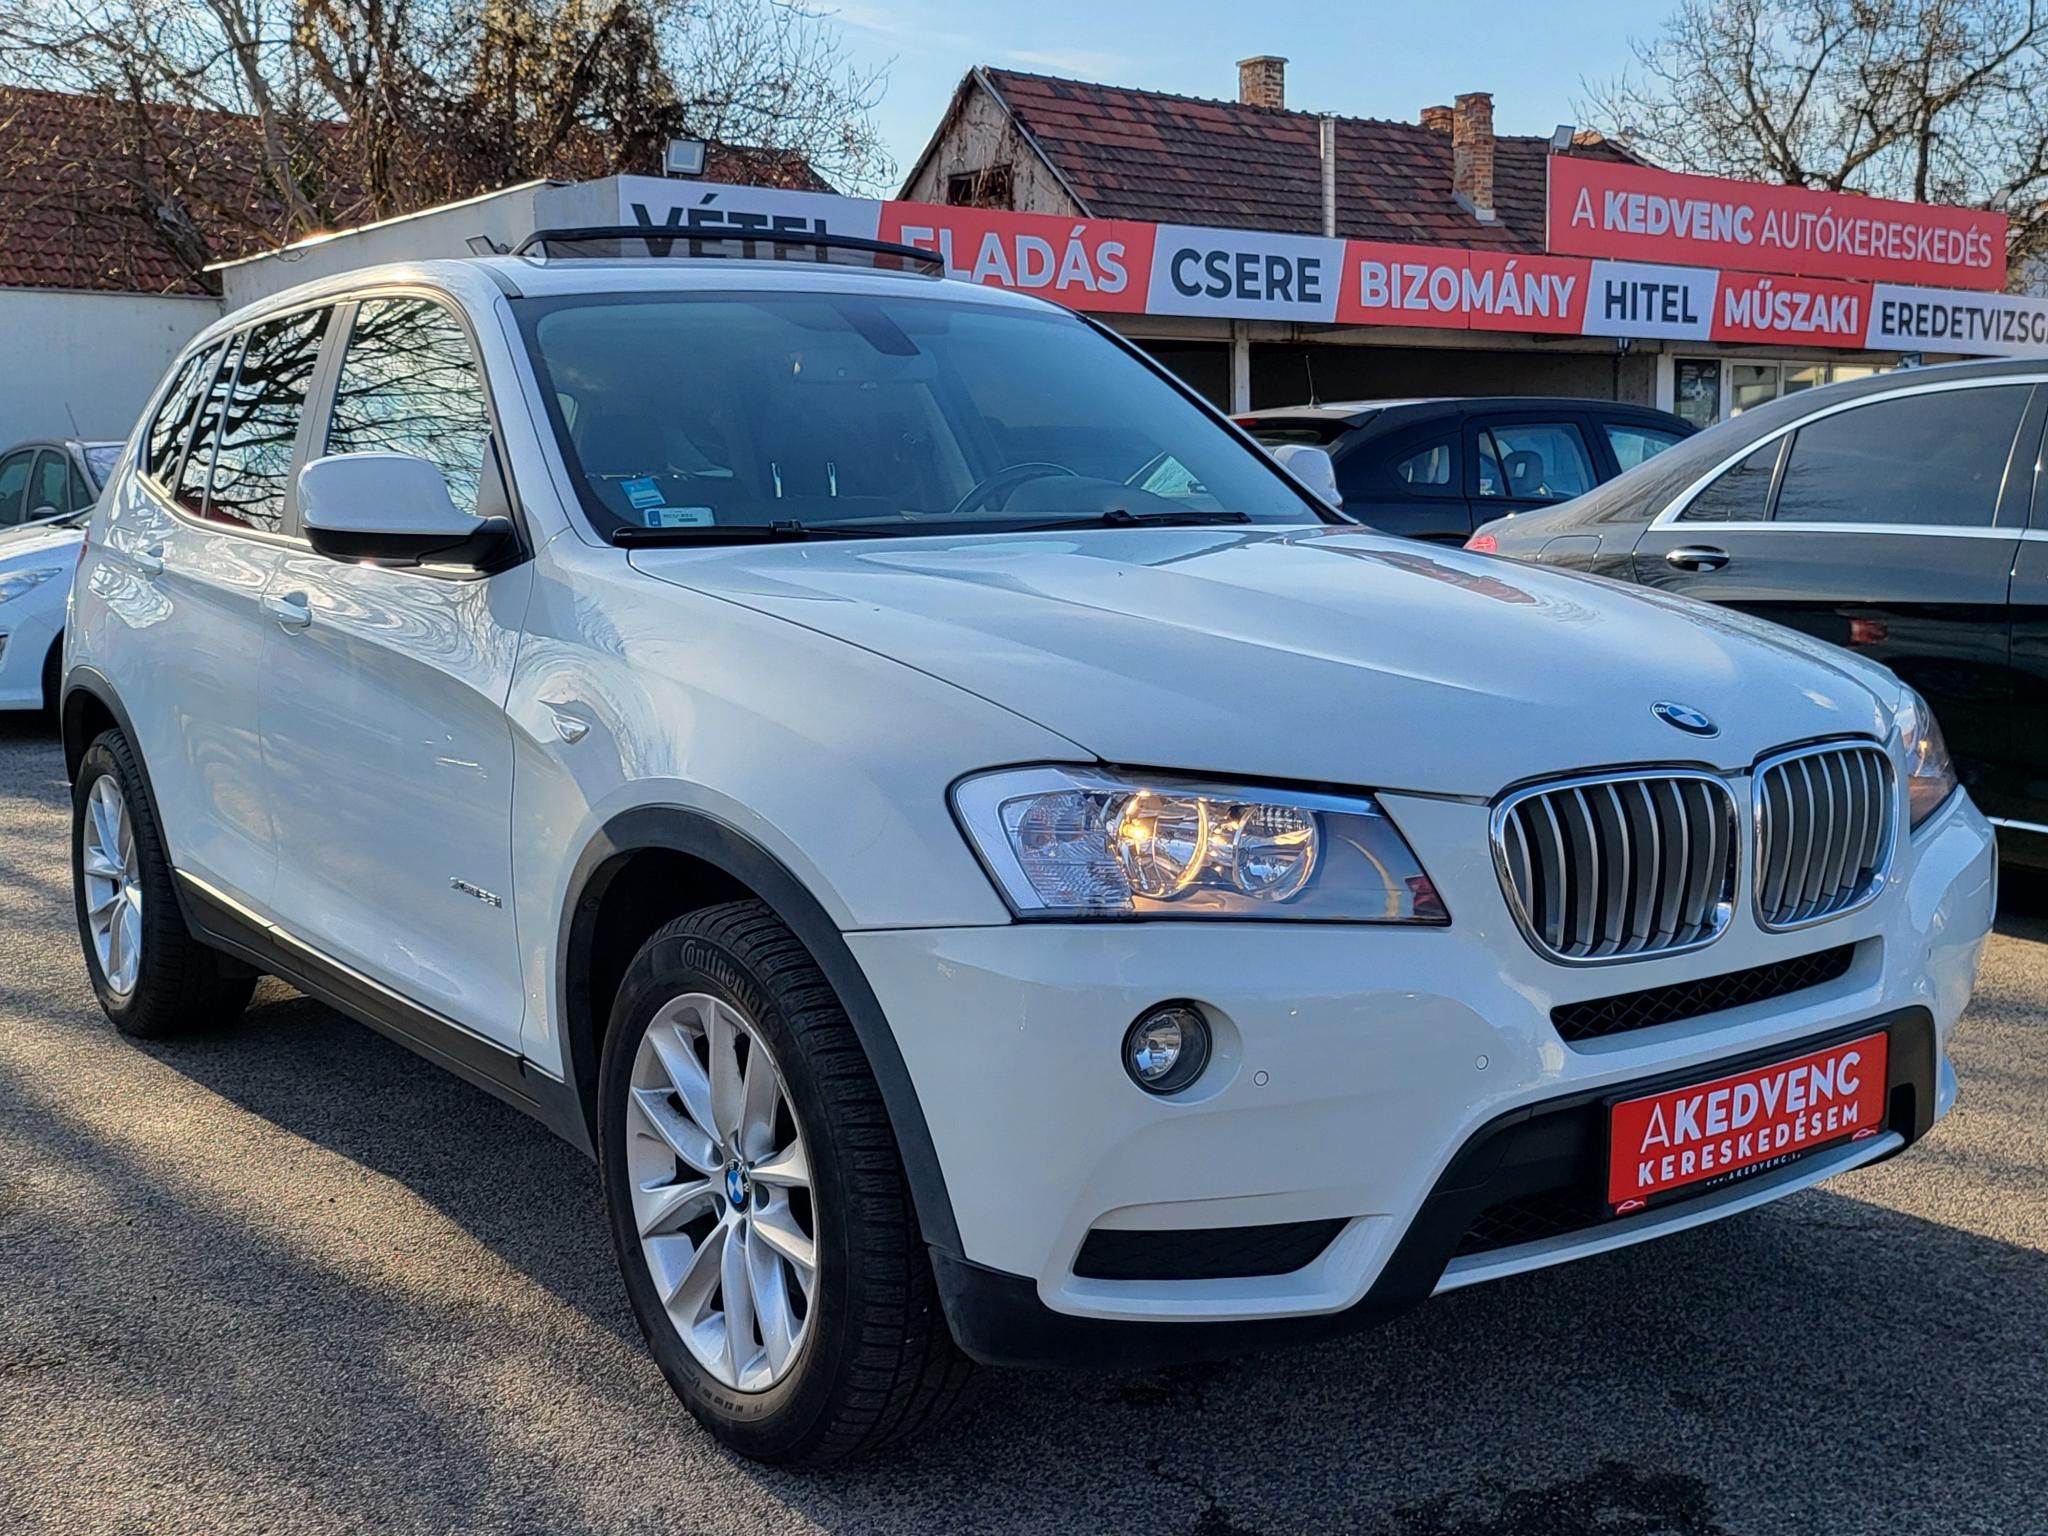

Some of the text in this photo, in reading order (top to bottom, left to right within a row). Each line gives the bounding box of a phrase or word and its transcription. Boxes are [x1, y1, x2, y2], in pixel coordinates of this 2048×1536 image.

[1571, 187, 1993, 269] A KEDVENC AUTÓKERESKEDÉS
[899, 224, 1129, 294] ELADÁS
[1170, 248, 1322, 303] CSERE
[1360, 260, 1576, 318] BIZOMÁNY
[1604, 280, 1699, 325] HITEL
[1724, 280, 1859, 335] MŰSZAKI
[1881, 300, 2048, 344] EREDETVIZSG
[1637, 1100, 1859, 1188] KERESKEDÉSEM
